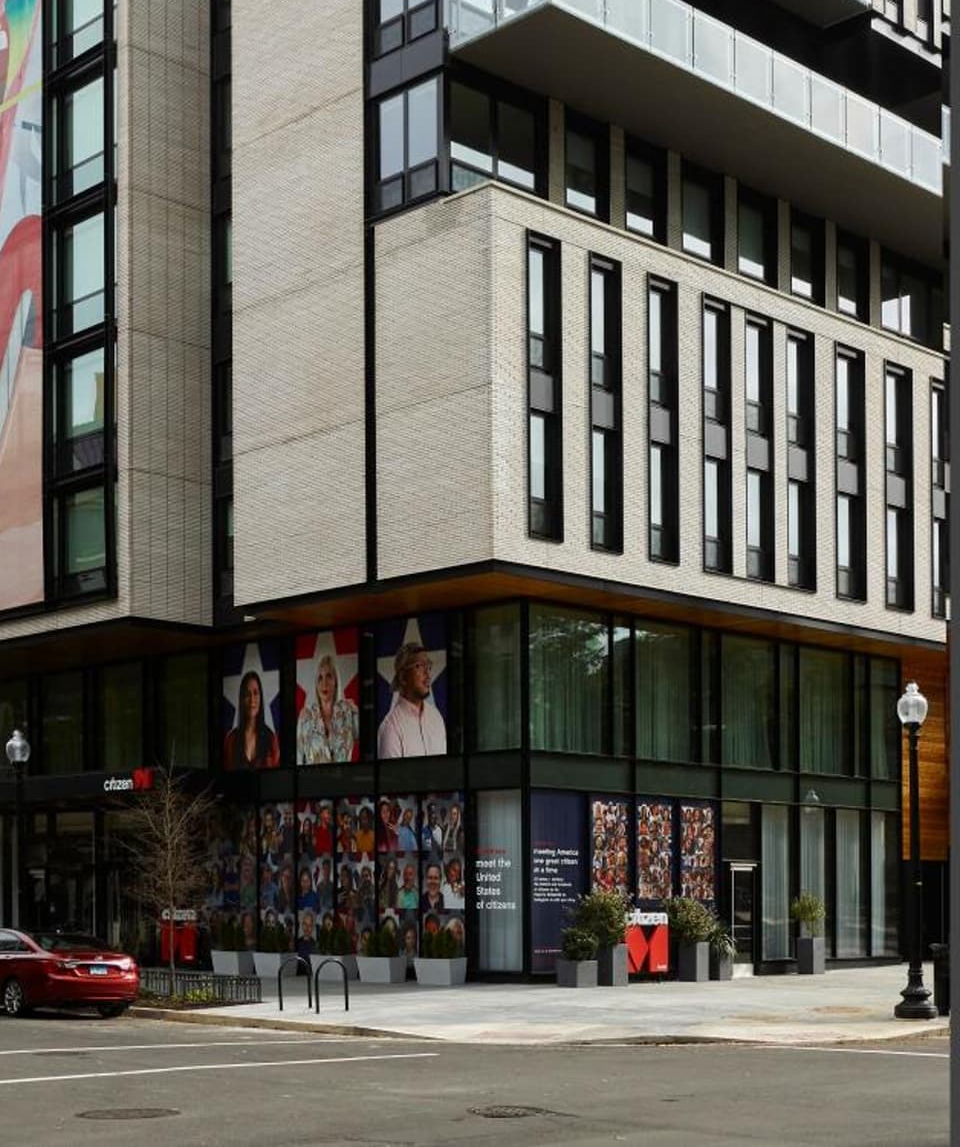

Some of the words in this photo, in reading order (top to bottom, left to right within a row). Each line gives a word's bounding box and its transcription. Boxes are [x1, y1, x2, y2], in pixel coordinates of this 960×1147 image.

[497, 857, 511, 868] the
[476, 872, 501, 882] United
[476, 886, 501, 896] States
